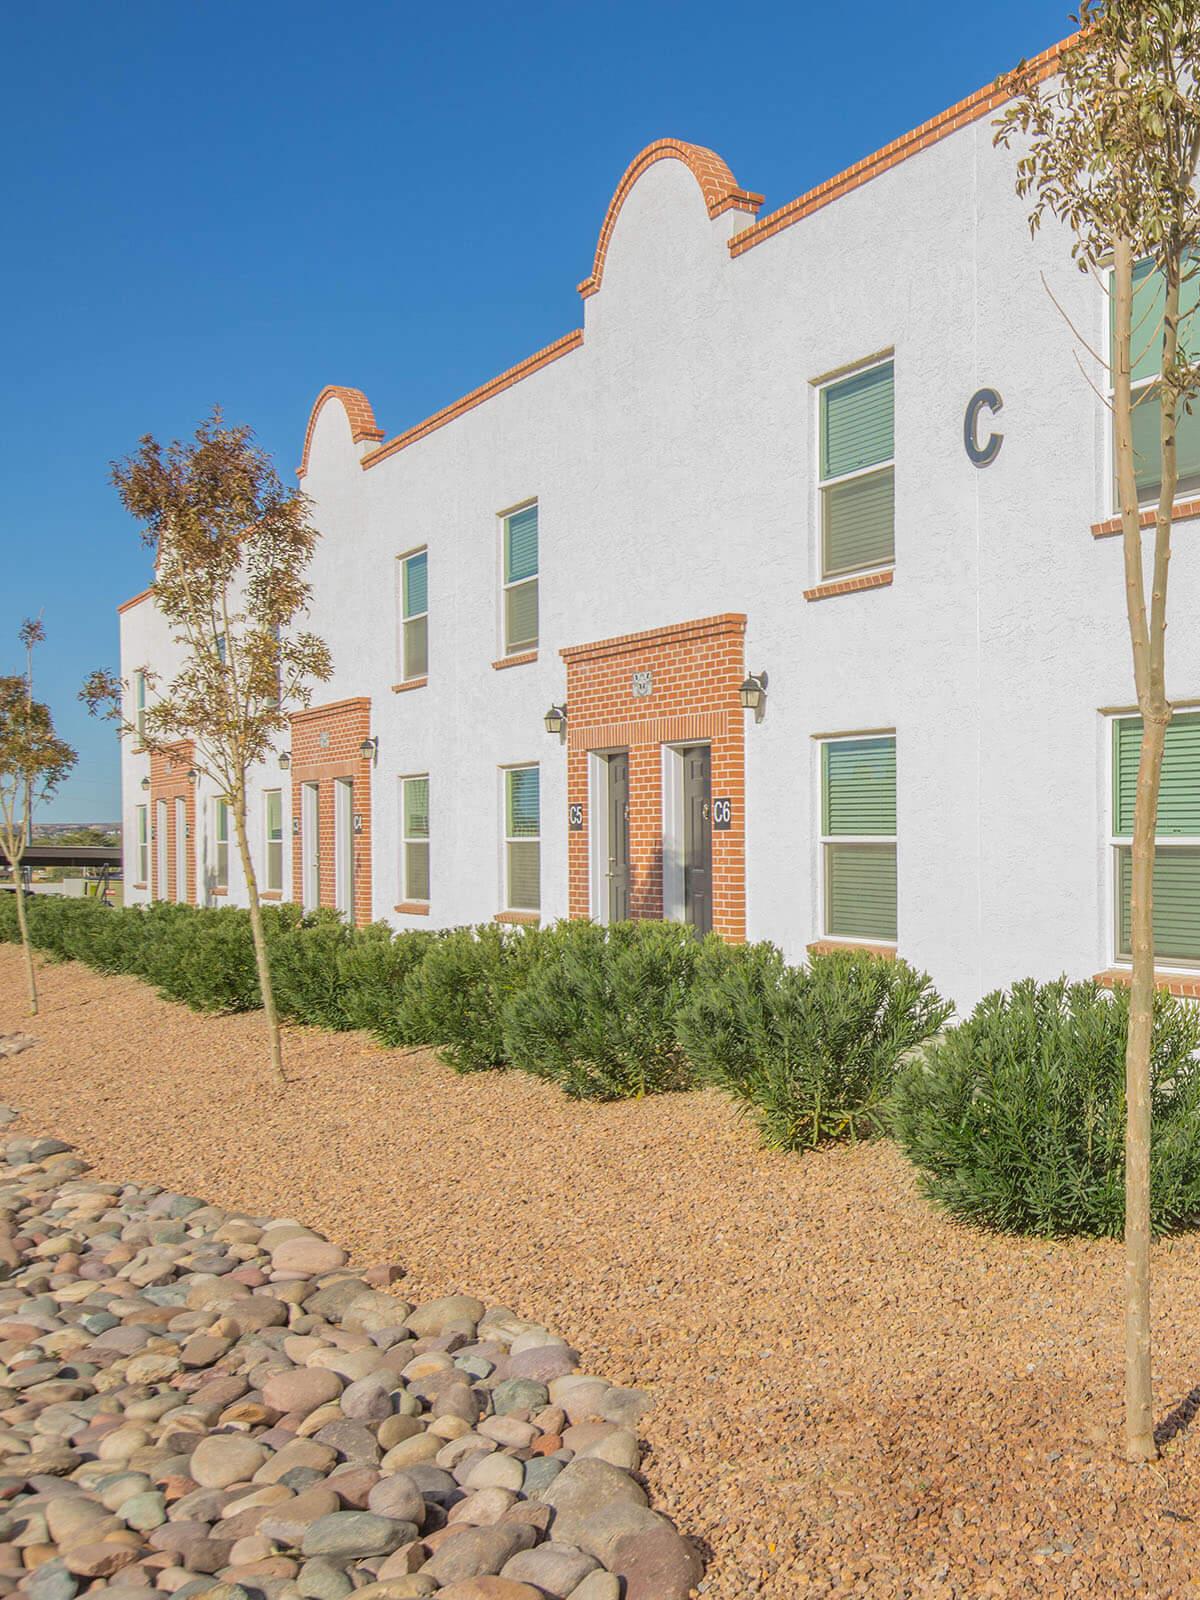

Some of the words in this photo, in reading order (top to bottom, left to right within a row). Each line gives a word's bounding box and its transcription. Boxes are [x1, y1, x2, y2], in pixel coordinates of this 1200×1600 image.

[964, 387, 1004, 469] C
[570, 806, 583, 824] C5
[714, 801, 730, 822] C6
